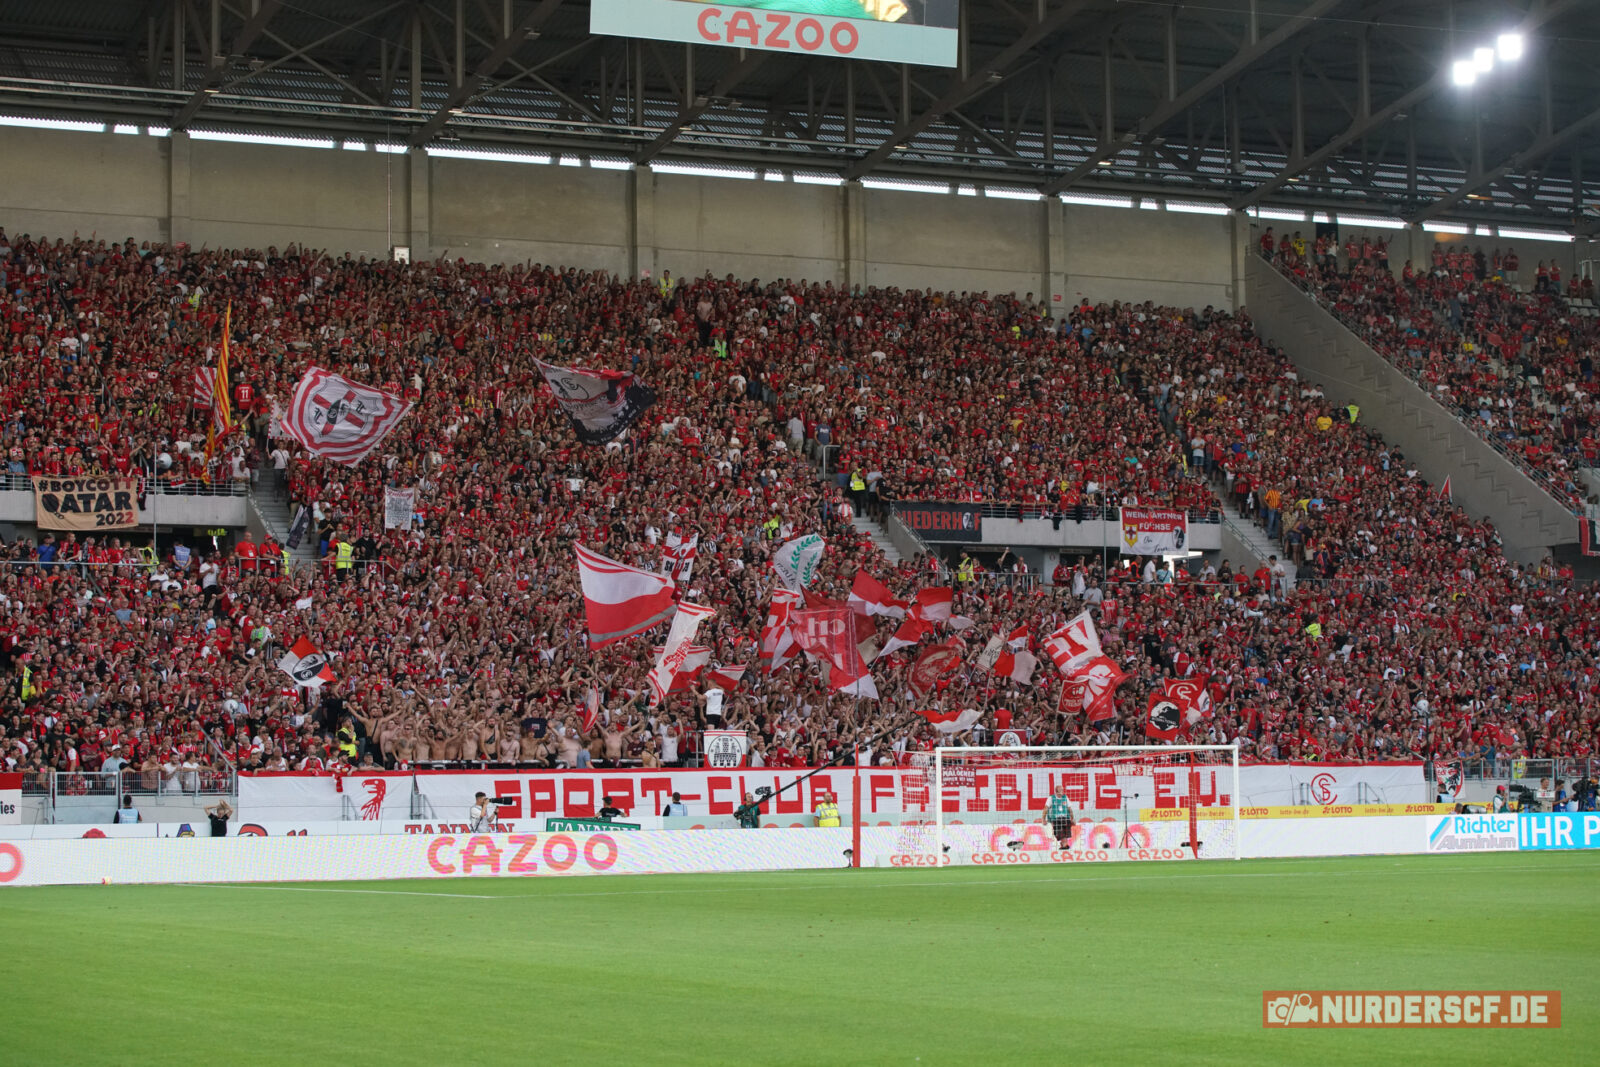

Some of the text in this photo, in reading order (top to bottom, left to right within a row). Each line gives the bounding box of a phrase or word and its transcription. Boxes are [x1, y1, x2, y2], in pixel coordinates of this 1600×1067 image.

[697, 8, 859, 54] CAZOO
[38, 477, 134, 492] #BOYCOTT
[96, 512, 134, 526] 2022
[494, 775, 838, 819] SPORT-CLUB
[1159, 810, 1183, 818] LOTTO
[1331, 806, 1353, 814] LOTTO
[1454, 816, 1515, 834] Richter
[1520, 816, 1574, 847] IHR
[1437, 834, 1516, 850] Aluminium
[427, 833, 619, 874] CAZOO
[971, 851, 1031, 865] CAZOO
[1050, 849, 1109, 862] CAZOO
[1128, 847, 1184, 861] CAZOO
